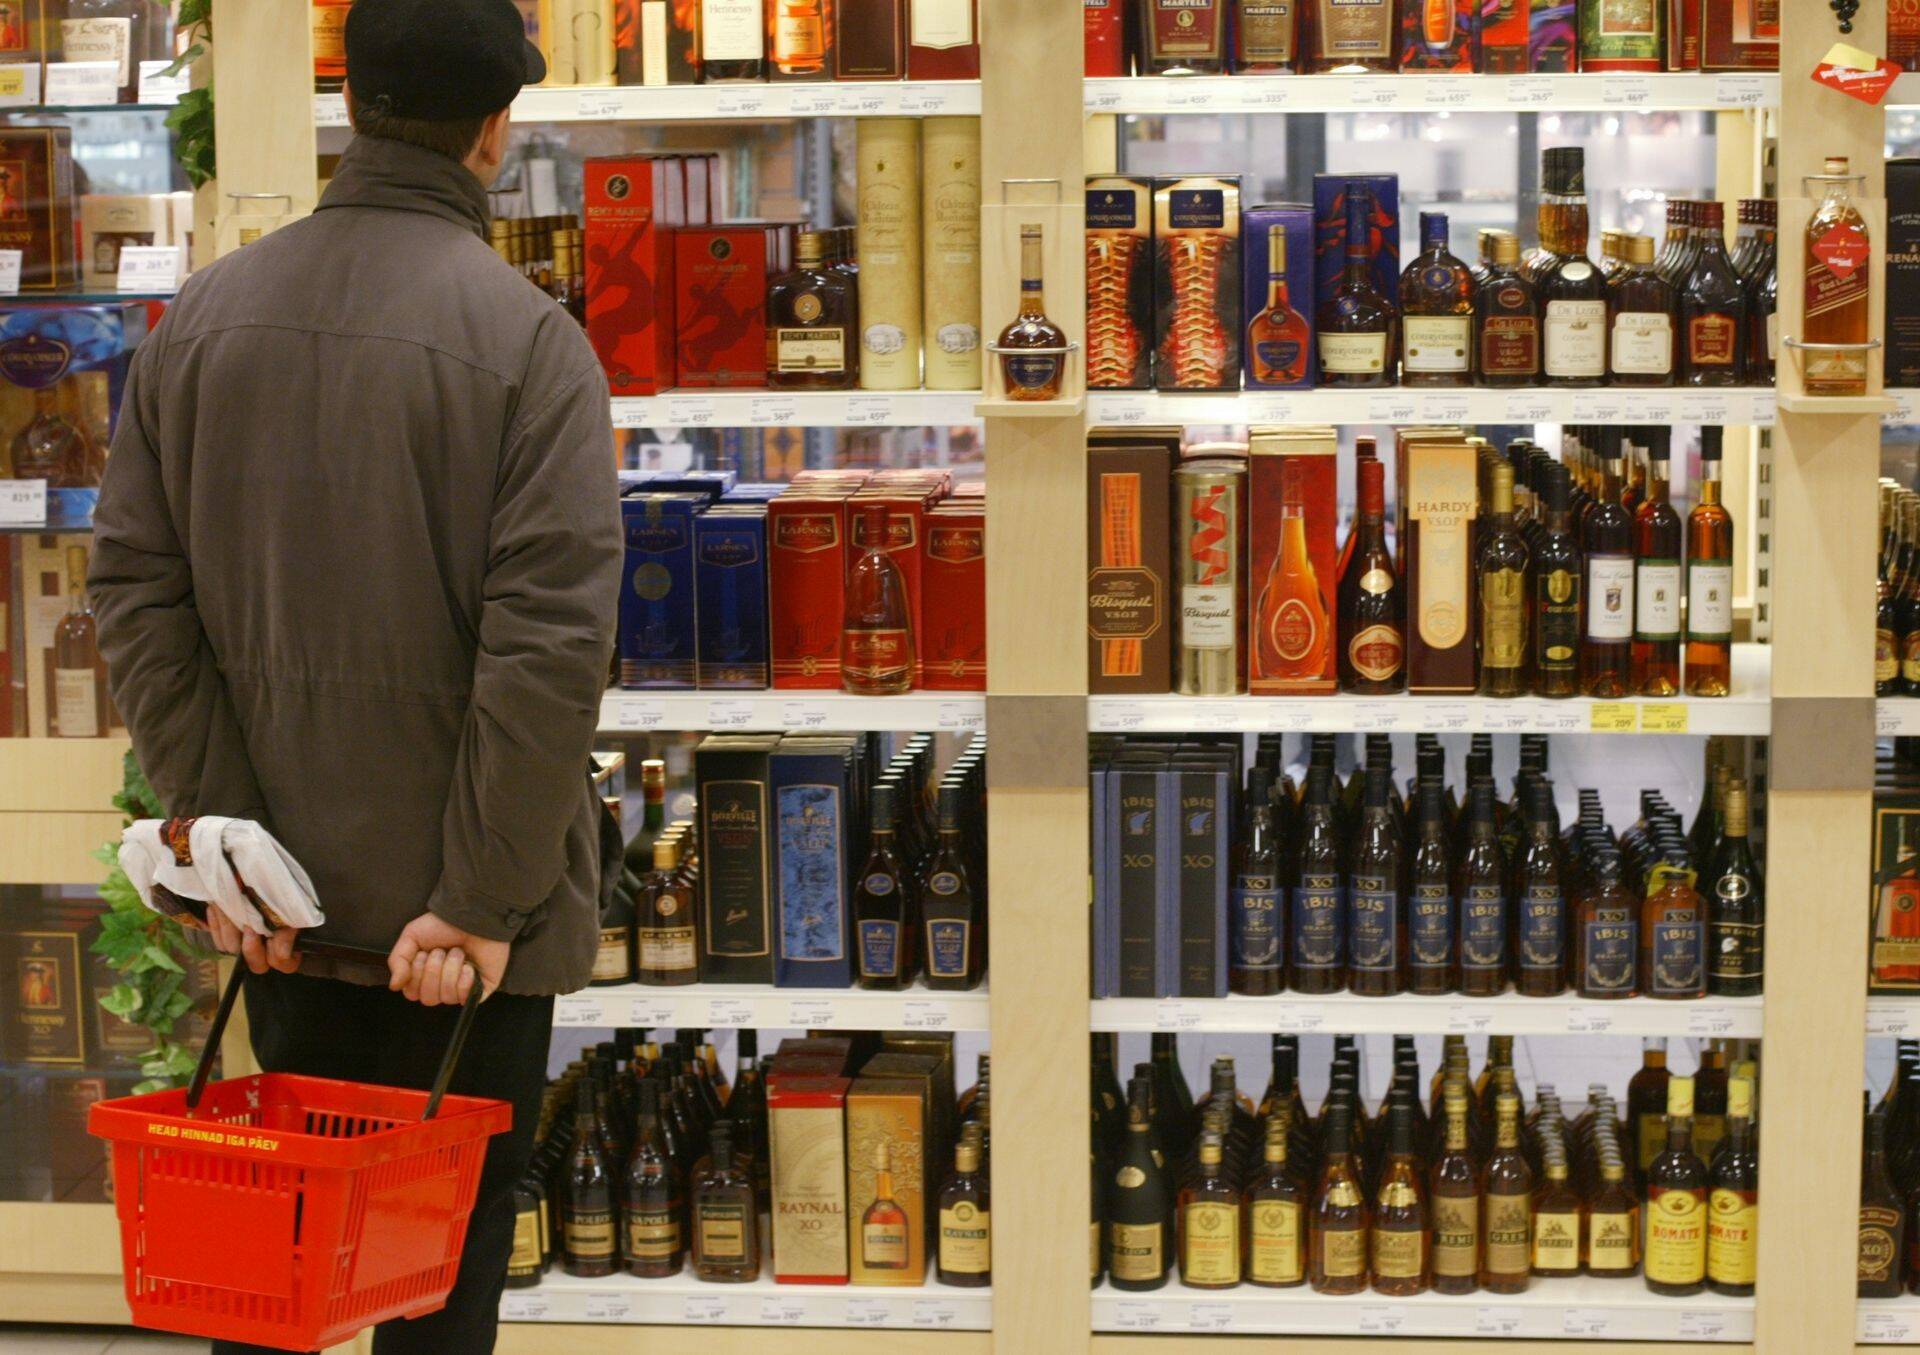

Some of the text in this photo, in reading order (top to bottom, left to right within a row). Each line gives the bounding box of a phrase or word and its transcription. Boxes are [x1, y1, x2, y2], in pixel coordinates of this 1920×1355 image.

[709, 4, 752, 14] Hennessy
[1417, 502, 1472, 512] HARDY
[781, 525, 832, 535] LARSEN
[932, 538, 980, 547] LARSEN
[1123, 796, 1154, 808] IBIS
[1182, 797, 1214, 808] IBIS
[1123, 854, 1155, 868] XO
[1183, 854, 1215, 868] XO
[1246, 879, 1267, 889] XO
[1310, 877, 1333, 888] XO
[1423, 888, 1442, 898] XO
[1476, 889, 1495, 899] XO
[1535, 889, 1553, 898] XO
[1302, 897, 1337, 910] IBIS
[1416, 904, 1448, 916] IBIS
[1469, 905, 1500, 917] IBIS
[1528, 905, 1559, 917] IBIS
[1603, 911, 1623, 922] XO
[1669, 911, 1691, 922] XO
[1594, 928, 1630, 940] IBIS
[1661, 928, 1696, 941] IBIS
[148, 1123, 279, 1151] HEAD HINNAD IGA PÄEV
[778, 1202, 842, 1214] RAYNAL
[800, 1219, 823, 1231] XO
[945, 1229, 987, 1239] RAYNAL
[1653, 1224, 1700, 1241] ROMATE
